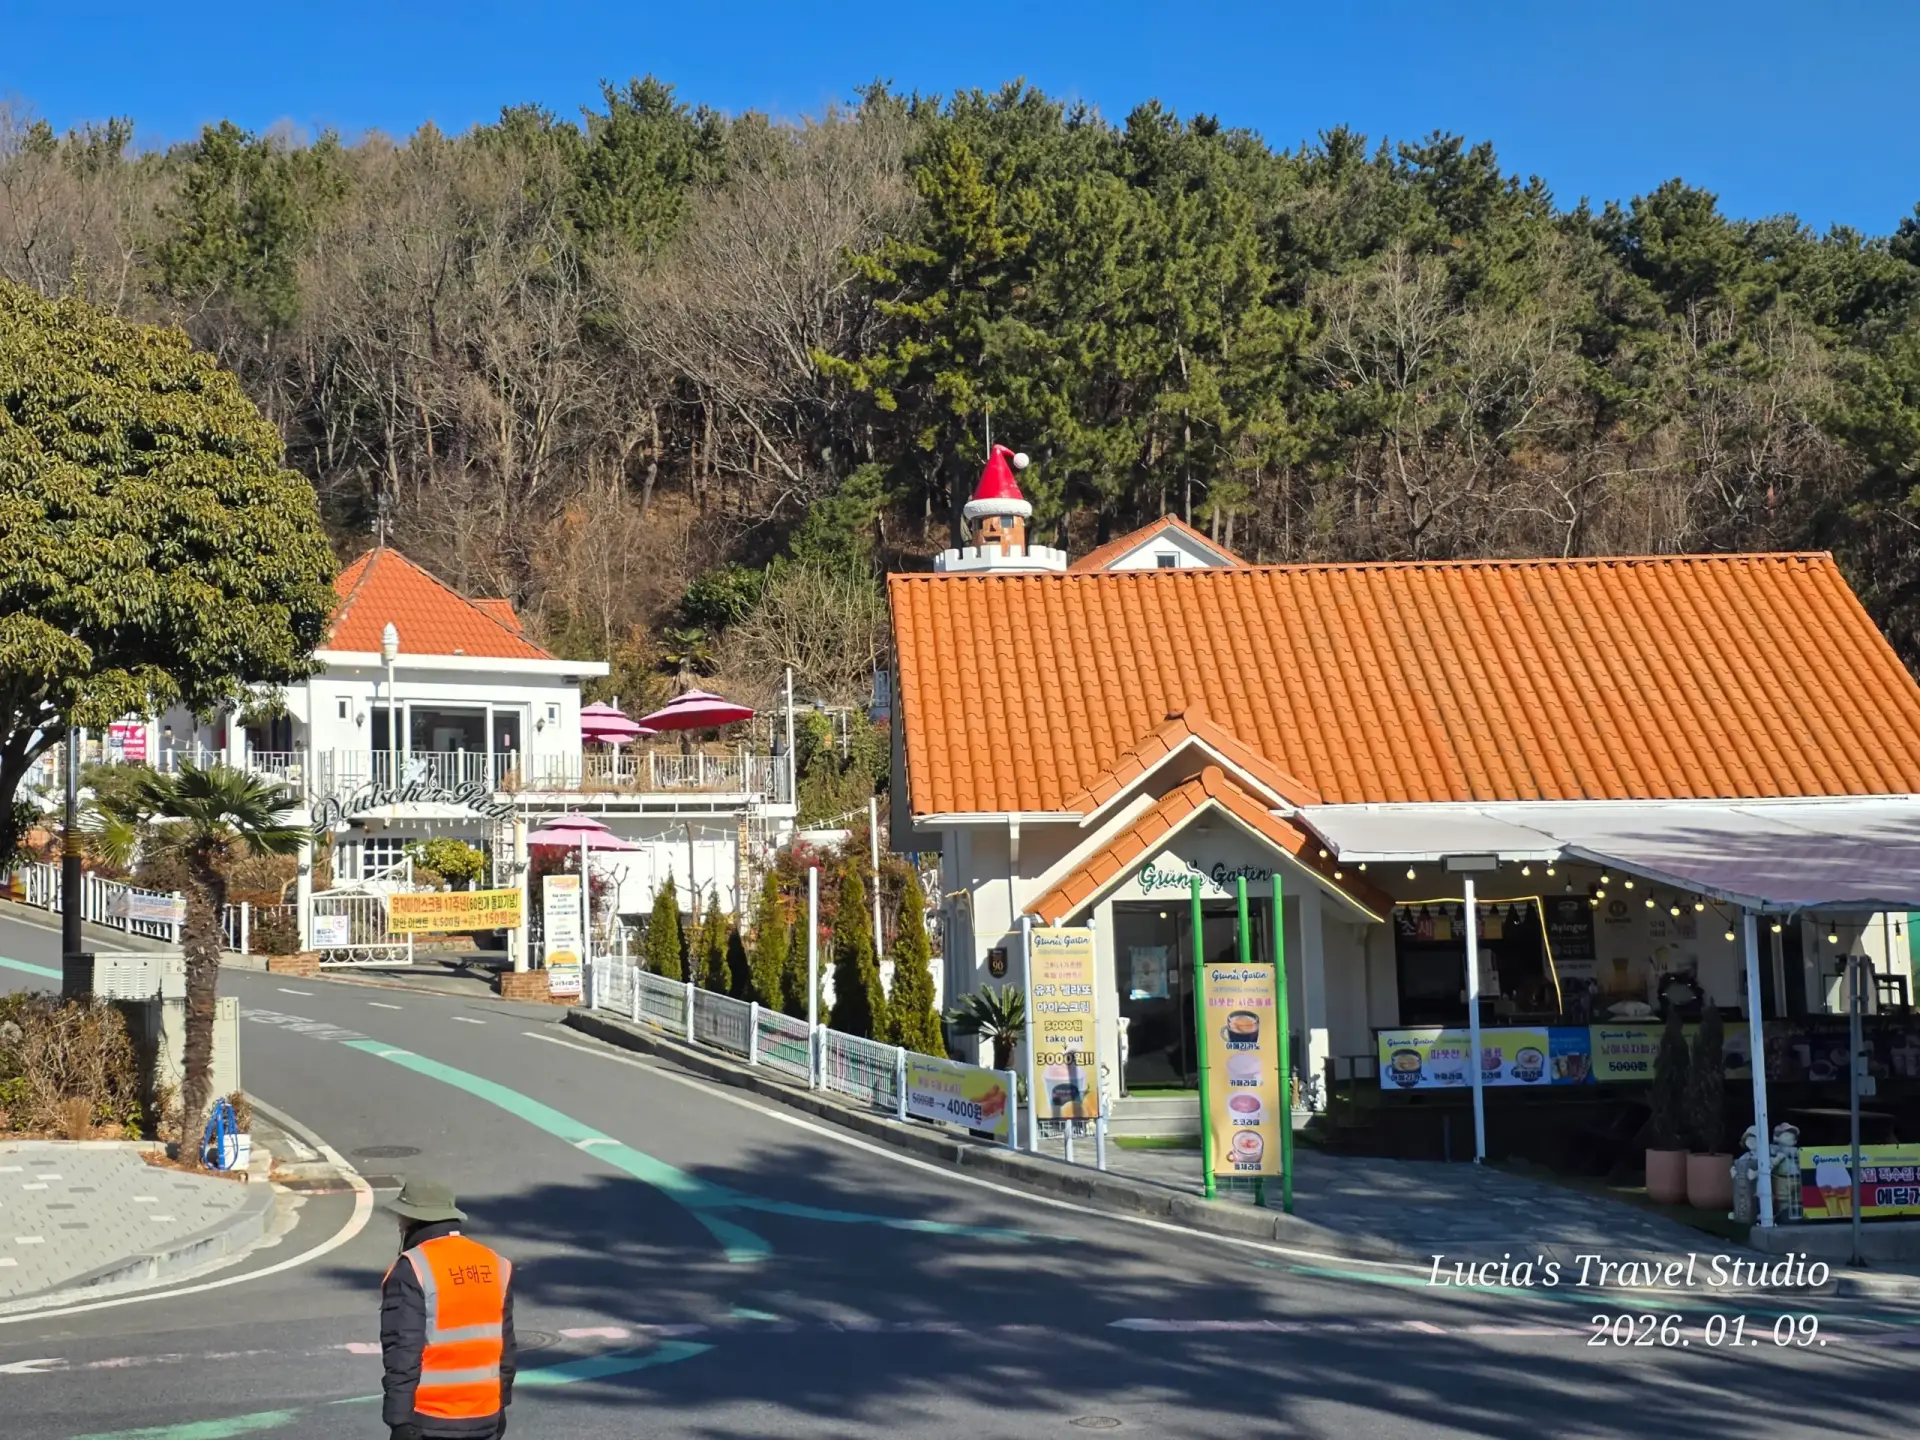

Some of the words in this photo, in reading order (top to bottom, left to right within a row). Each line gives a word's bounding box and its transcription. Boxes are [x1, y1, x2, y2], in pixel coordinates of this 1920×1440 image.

[311, 781, 446, 835] Deutscher
[450, 781, 517, 823] Park
[1551, 923, 1588, 933] Ayinger
[1035, 984, 1056, 996] 유자
[1036, 1001, 1091, 1013] 아이스크림
[1044, 1020, 1083, 1032] 5000원
[1045, 1035, 1066, 1043] take
[1068, 1035, 1084, 1043] out
[1036, 1051, 1095, 1066] 3000원!!
[1430, 1048, 1460, 1060] 따뜻한
[1609, 1061, 1648, 1072] 5000원
[947, 1098, 982, 1121] 4000원
[1879, 1166, 1914, 1182] 직수입
[448, 1264, 493, 1285] 남해군
